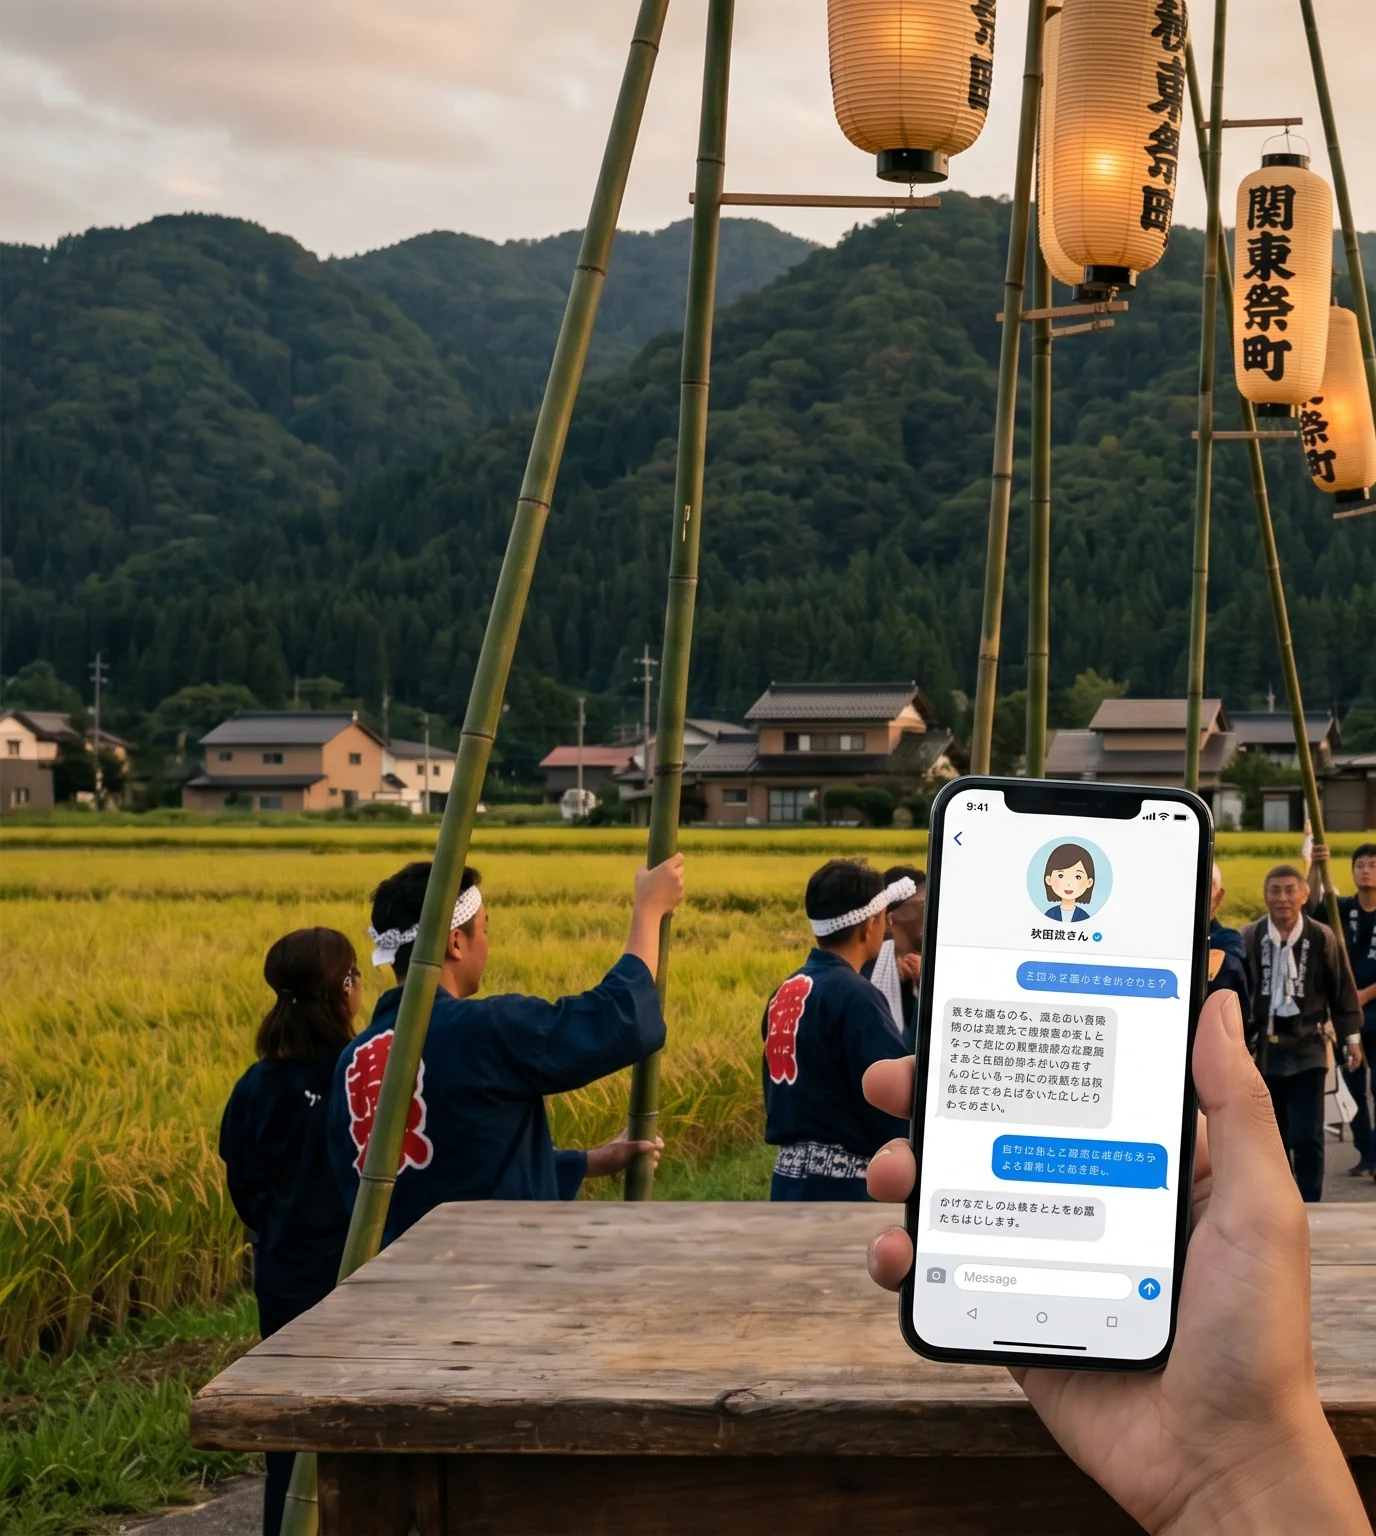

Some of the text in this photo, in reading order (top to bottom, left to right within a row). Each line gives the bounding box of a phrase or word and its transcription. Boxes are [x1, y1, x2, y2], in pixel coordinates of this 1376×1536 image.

[1243, 184, 1296, 381] 関東祭町
[966, 802, 989, 812] 9:41
[963, 1271, 1018, 1288] Message
